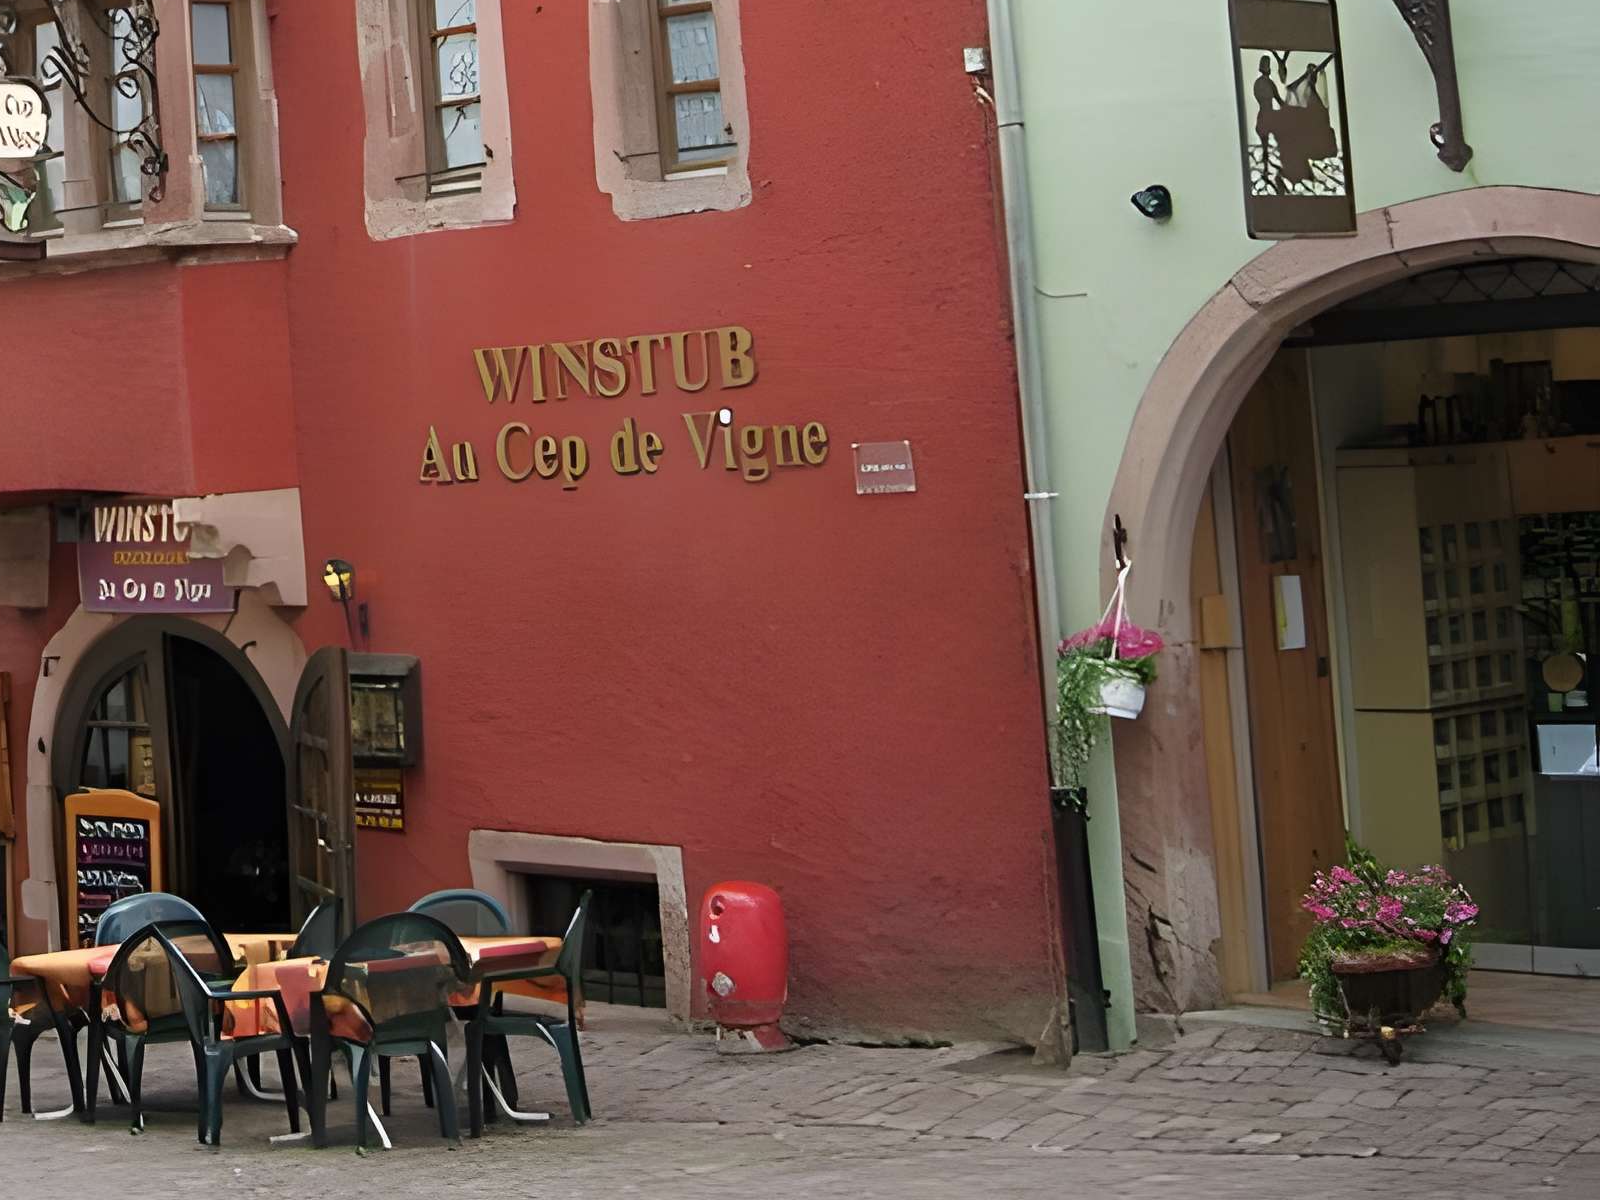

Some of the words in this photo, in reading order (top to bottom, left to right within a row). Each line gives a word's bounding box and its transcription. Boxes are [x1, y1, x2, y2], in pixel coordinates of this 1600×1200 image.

[472, 325, 757, 402] WINSTUB
[418, 425, 480, 484] Au
[495, 421, 590, 490] Cep
[610, 416, 664, 474] de
[681, 408, 830, 483] Vigne
